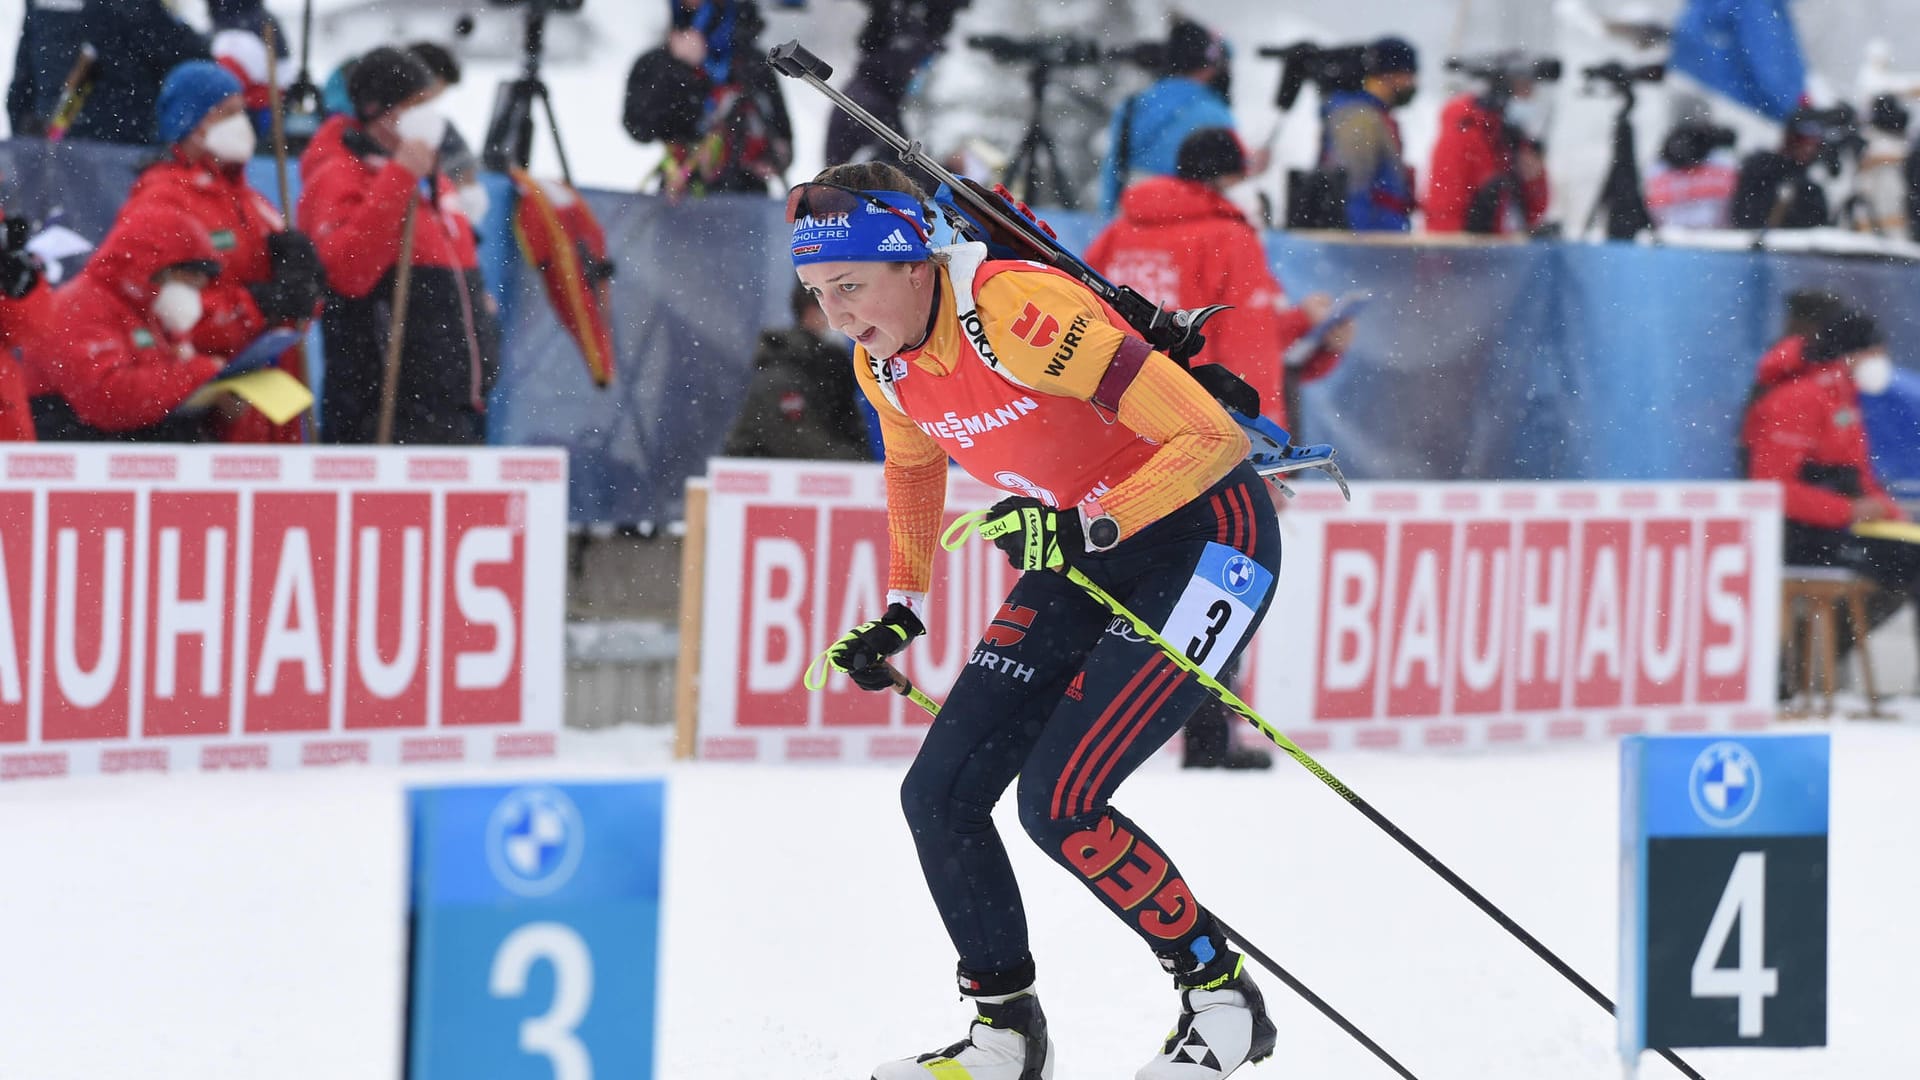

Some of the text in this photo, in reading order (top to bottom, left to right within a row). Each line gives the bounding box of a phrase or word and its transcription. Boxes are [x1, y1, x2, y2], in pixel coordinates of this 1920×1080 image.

[877, 243, 913, 252] adidas
[959, 309, 999, 369] JOKA
[1044, 315, 1090, 378] WÜRTH
[0, 526, 517, 708] UHAUS
[1185, 599, 1232, 667] 3
[1323, 545, 1747, 690] BAUHAUS
[1061, 816, 1198, 940] GER
[490, 919, 594, 1080] 3
[1690, 850, 1778, 1038] 4
